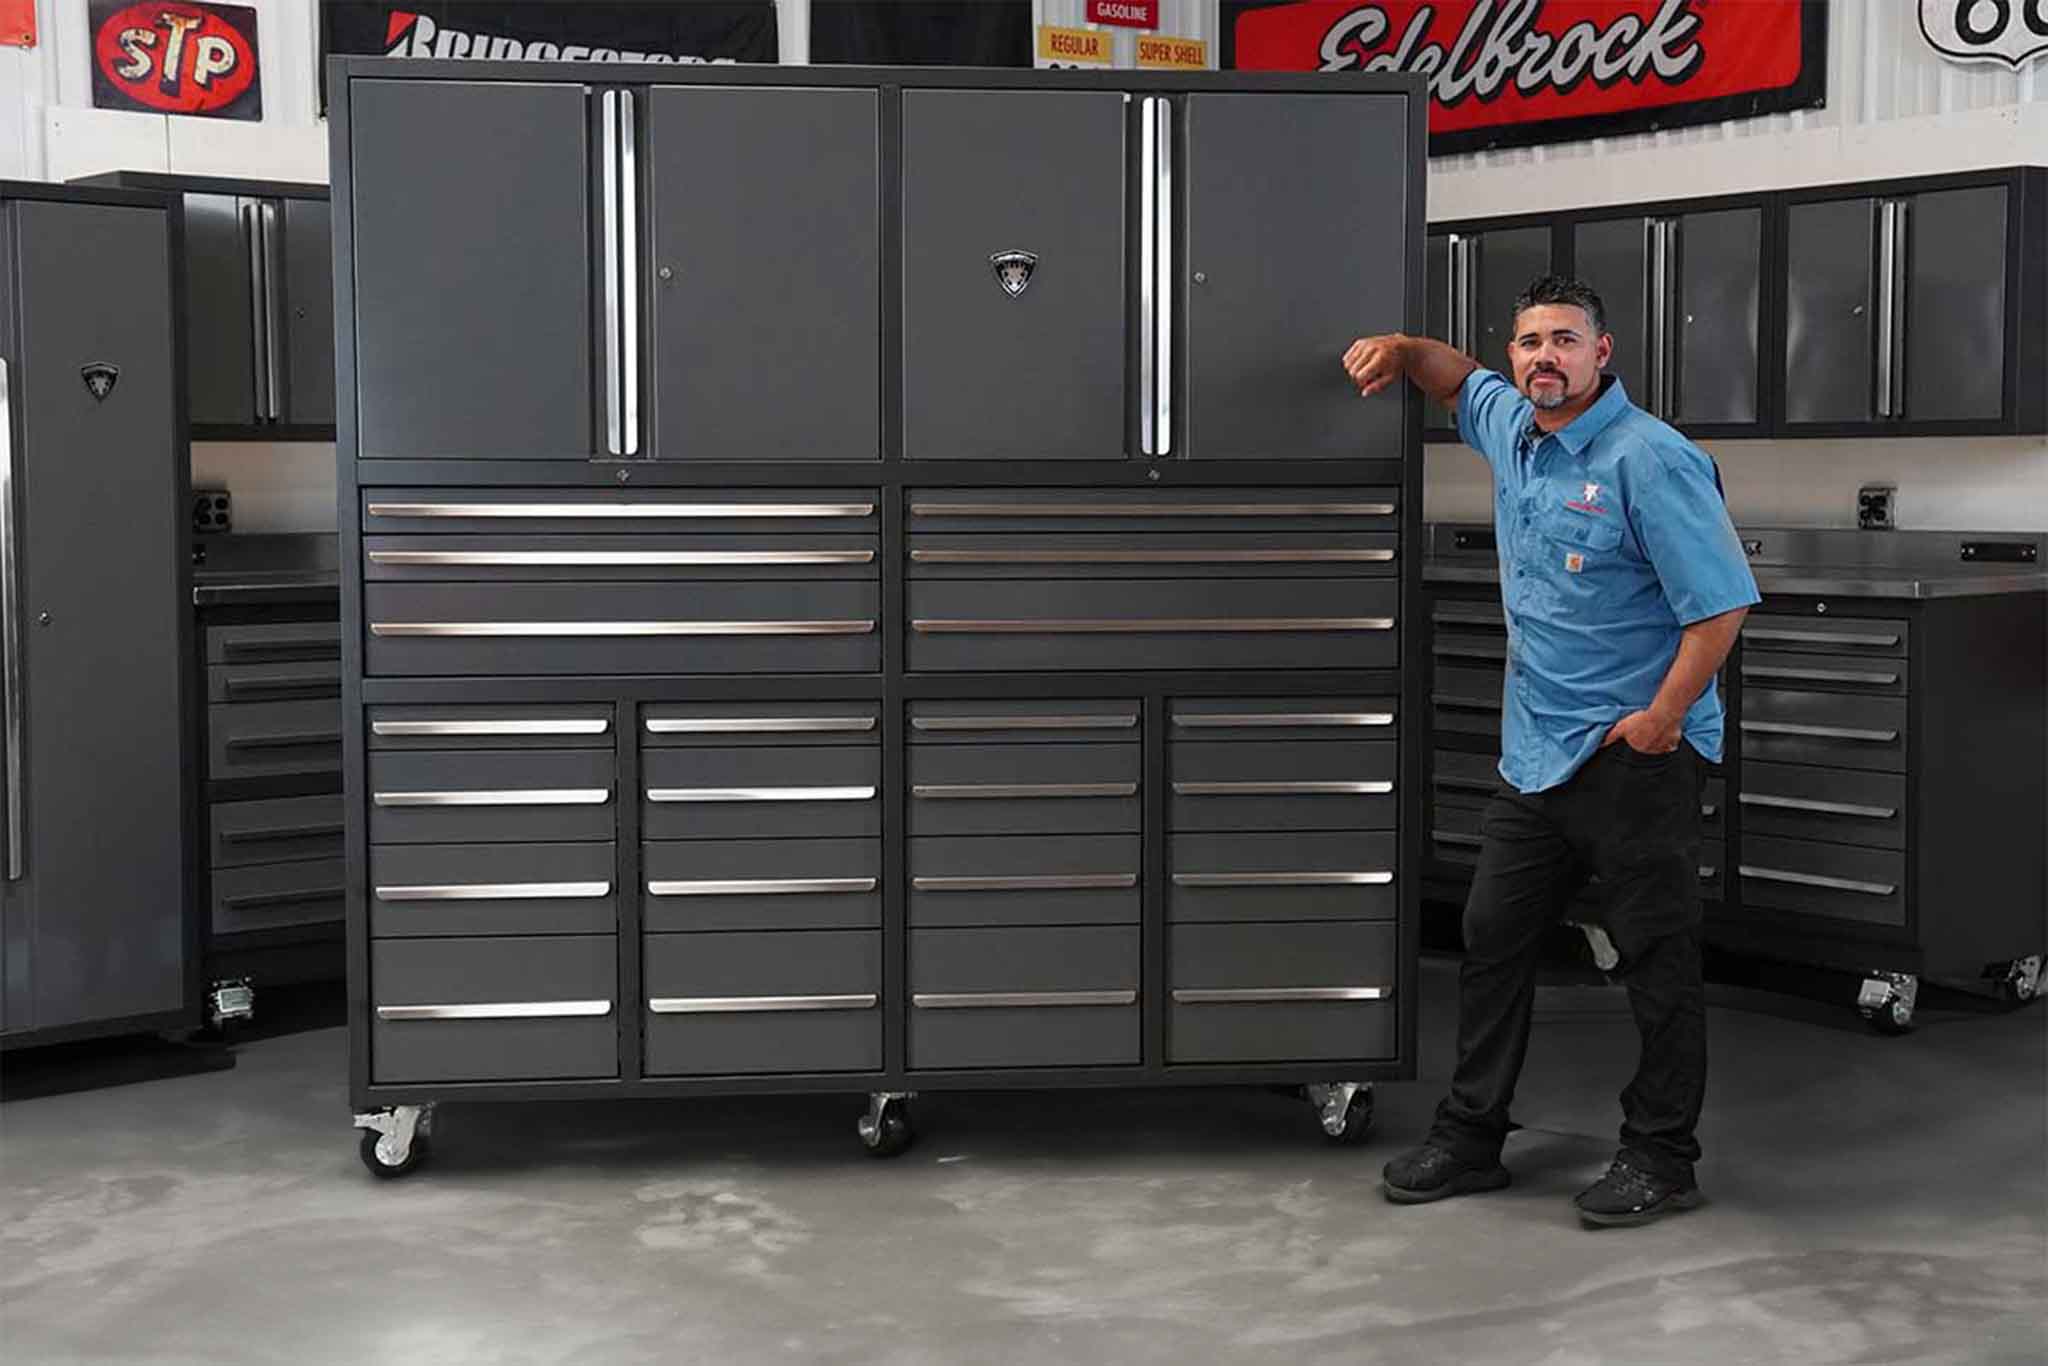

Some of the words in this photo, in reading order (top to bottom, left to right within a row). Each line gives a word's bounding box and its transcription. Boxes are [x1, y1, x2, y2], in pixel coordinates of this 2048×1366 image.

[1097, 2, 1148, 21] GASOLINE
[116, 12, 237, 86] STP
[1050, 33, 1099, 56] REGULAR
[1139, 41, 1172, 62] SUPER
[1174, 45, 1204, 65] SHELL
